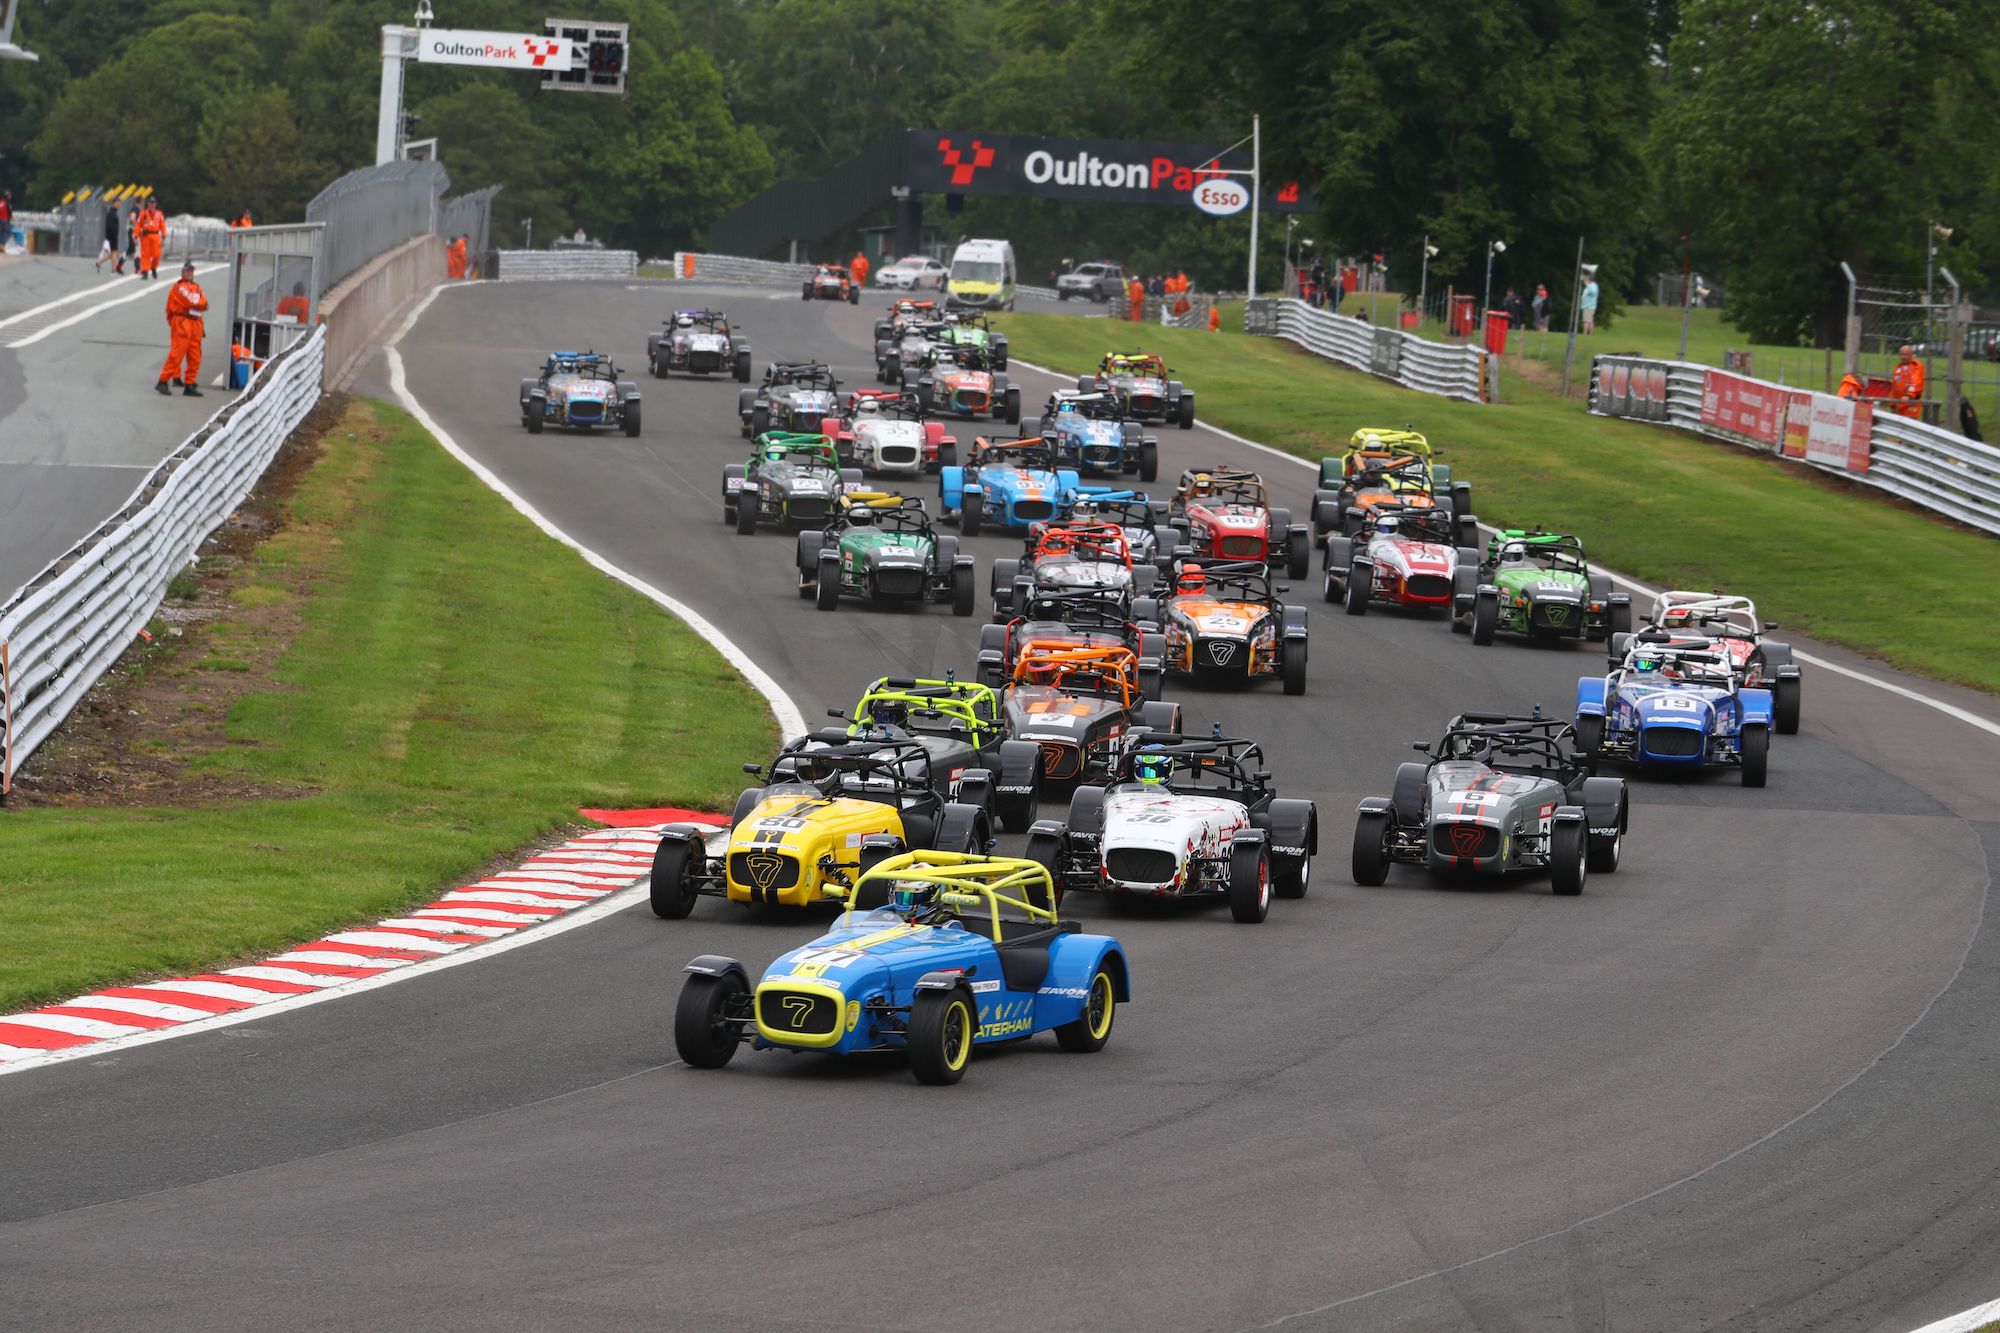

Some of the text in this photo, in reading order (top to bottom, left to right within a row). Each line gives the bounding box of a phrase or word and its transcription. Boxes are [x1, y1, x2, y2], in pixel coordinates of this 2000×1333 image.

[433, 41, 517, 59] OultonPark
[1201, 188, 1240, 206] Esso
[1208, 617, 1241, 626] 25
[1549, 605, 1567, 623] 7
[1212, 643, 1234, 663] 7
[1662, 699, 1690, 709] 19
[1002, 785, 1034, 793] AVON
[1464, 791, 1484, 801] 6
[760, 816, 806, 829] 80
[1453, 828, 1480, 852] 7
[1272, 845, 1306, 853] AVON
[751, 858, 779, 885] 7
[943, 894, 976, 905] FRENCH
[1048, 986, 1089, 997] AVON
[782, 996, 815, 1028] 7
[974, 1016, 1033, 1039] ATERHAM
